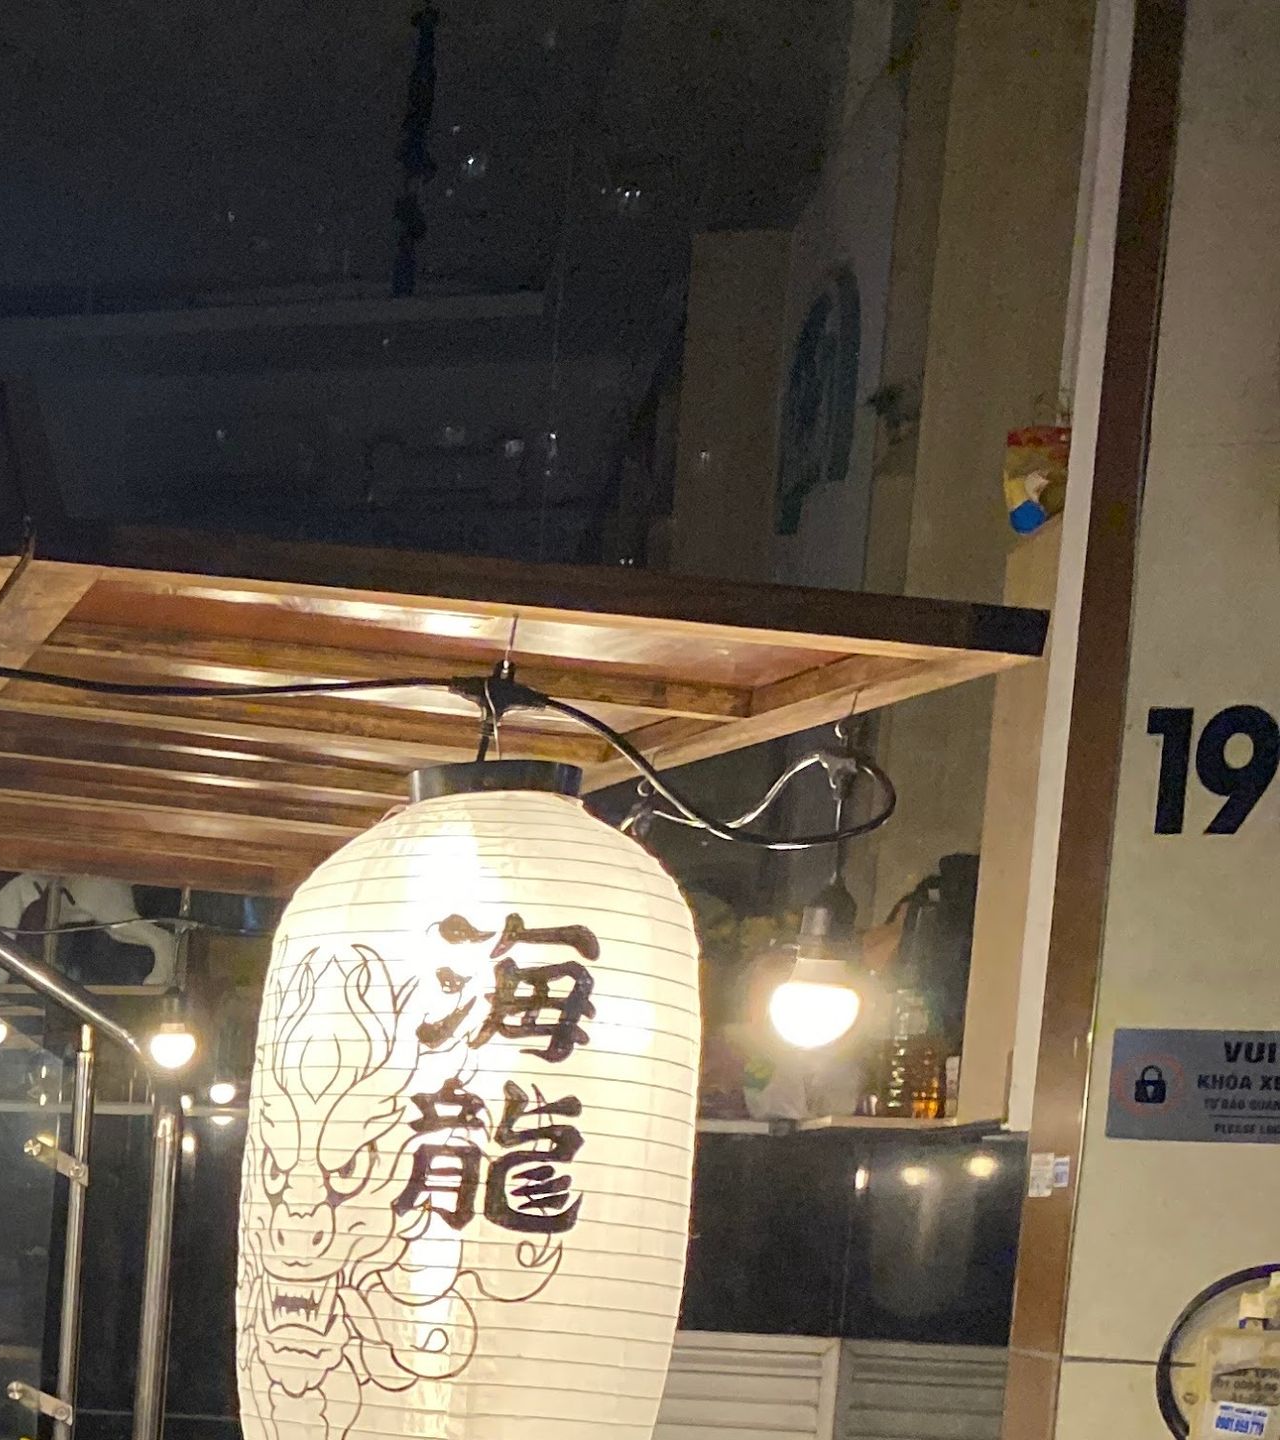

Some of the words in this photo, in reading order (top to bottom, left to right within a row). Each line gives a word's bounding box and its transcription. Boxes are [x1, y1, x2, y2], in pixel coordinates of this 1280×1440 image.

[1146, 704, 1280, 835] 19
[392, 912, 601, 1234] 海龍
[1223, 1041, 1277, 1064] VUI
